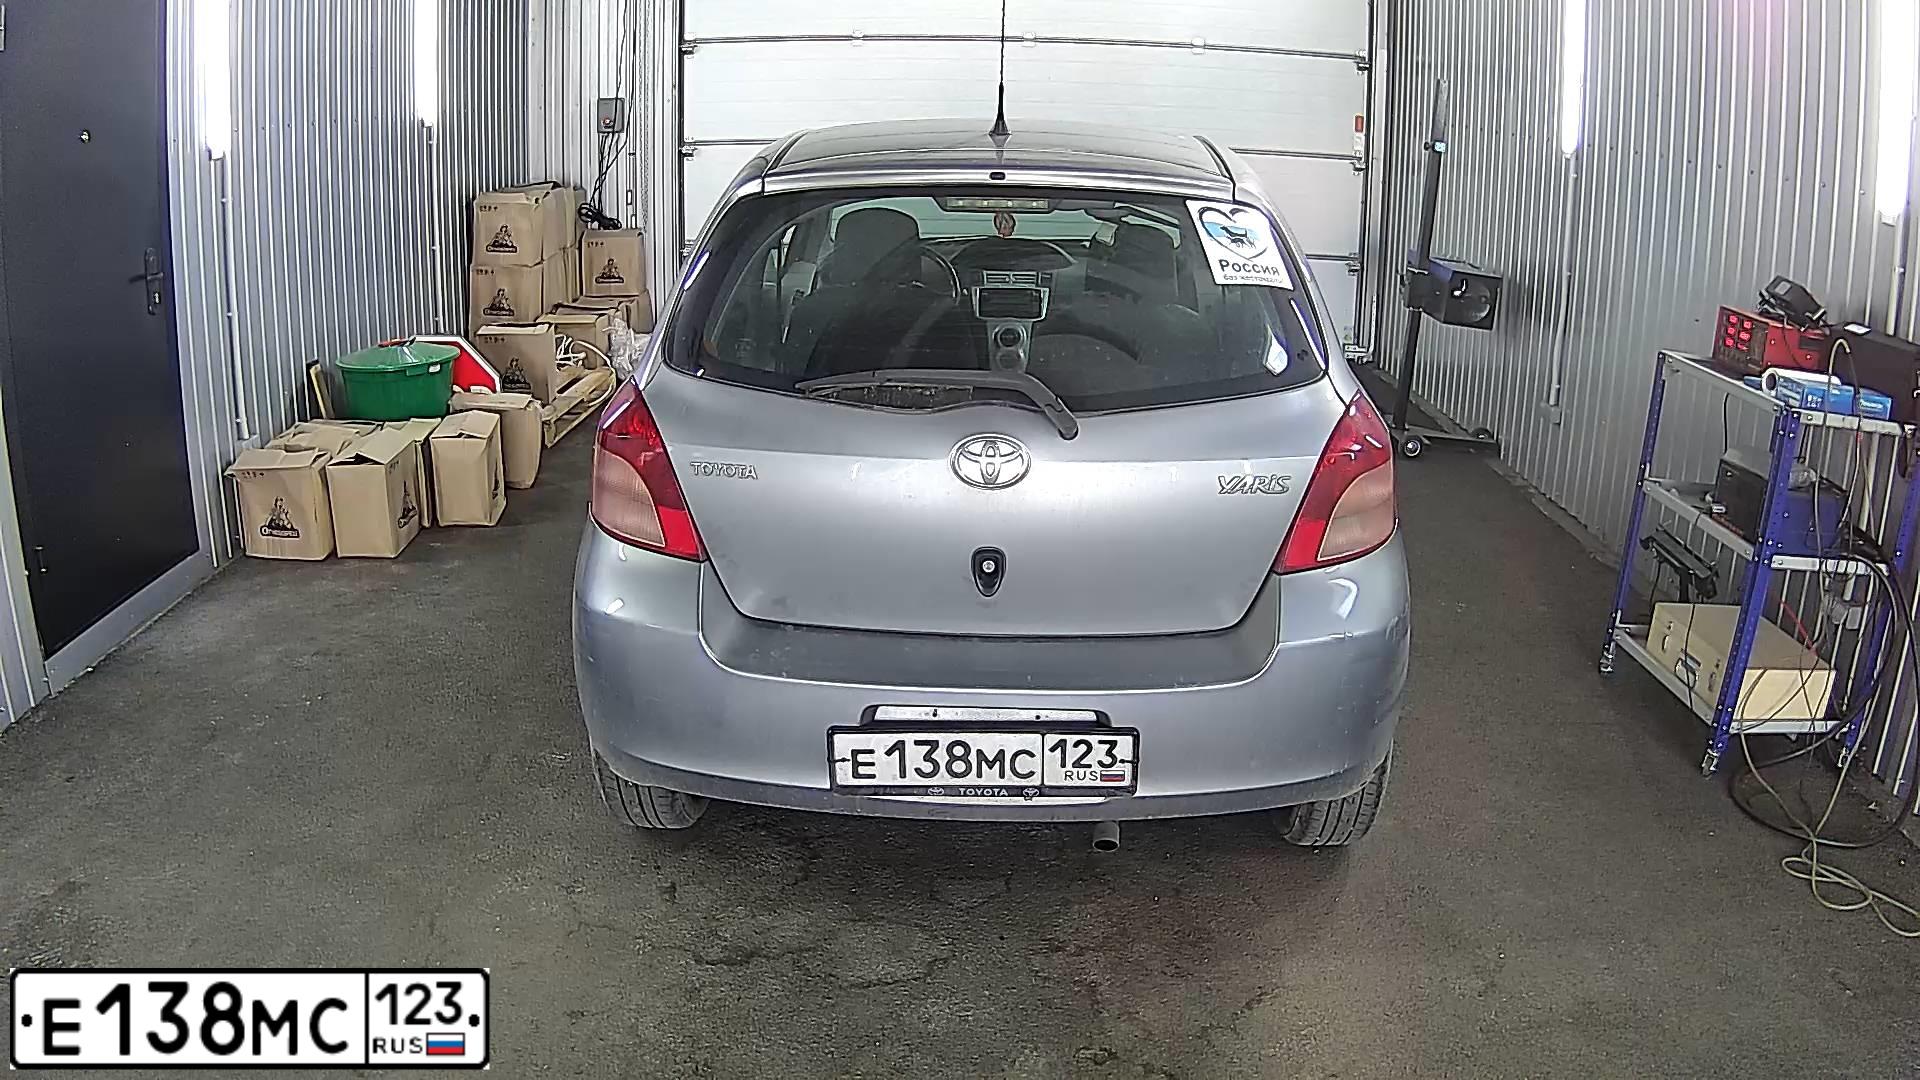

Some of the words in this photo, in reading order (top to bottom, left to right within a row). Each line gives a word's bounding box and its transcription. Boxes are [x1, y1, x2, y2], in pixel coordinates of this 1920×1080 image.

[690, 461, 758, 480] TOYOTA
[1048, 738, 1118, 768] 123
[1064, 770, 1098, 782] RUS
[959, 787, 1009, 797] TOYOTA
